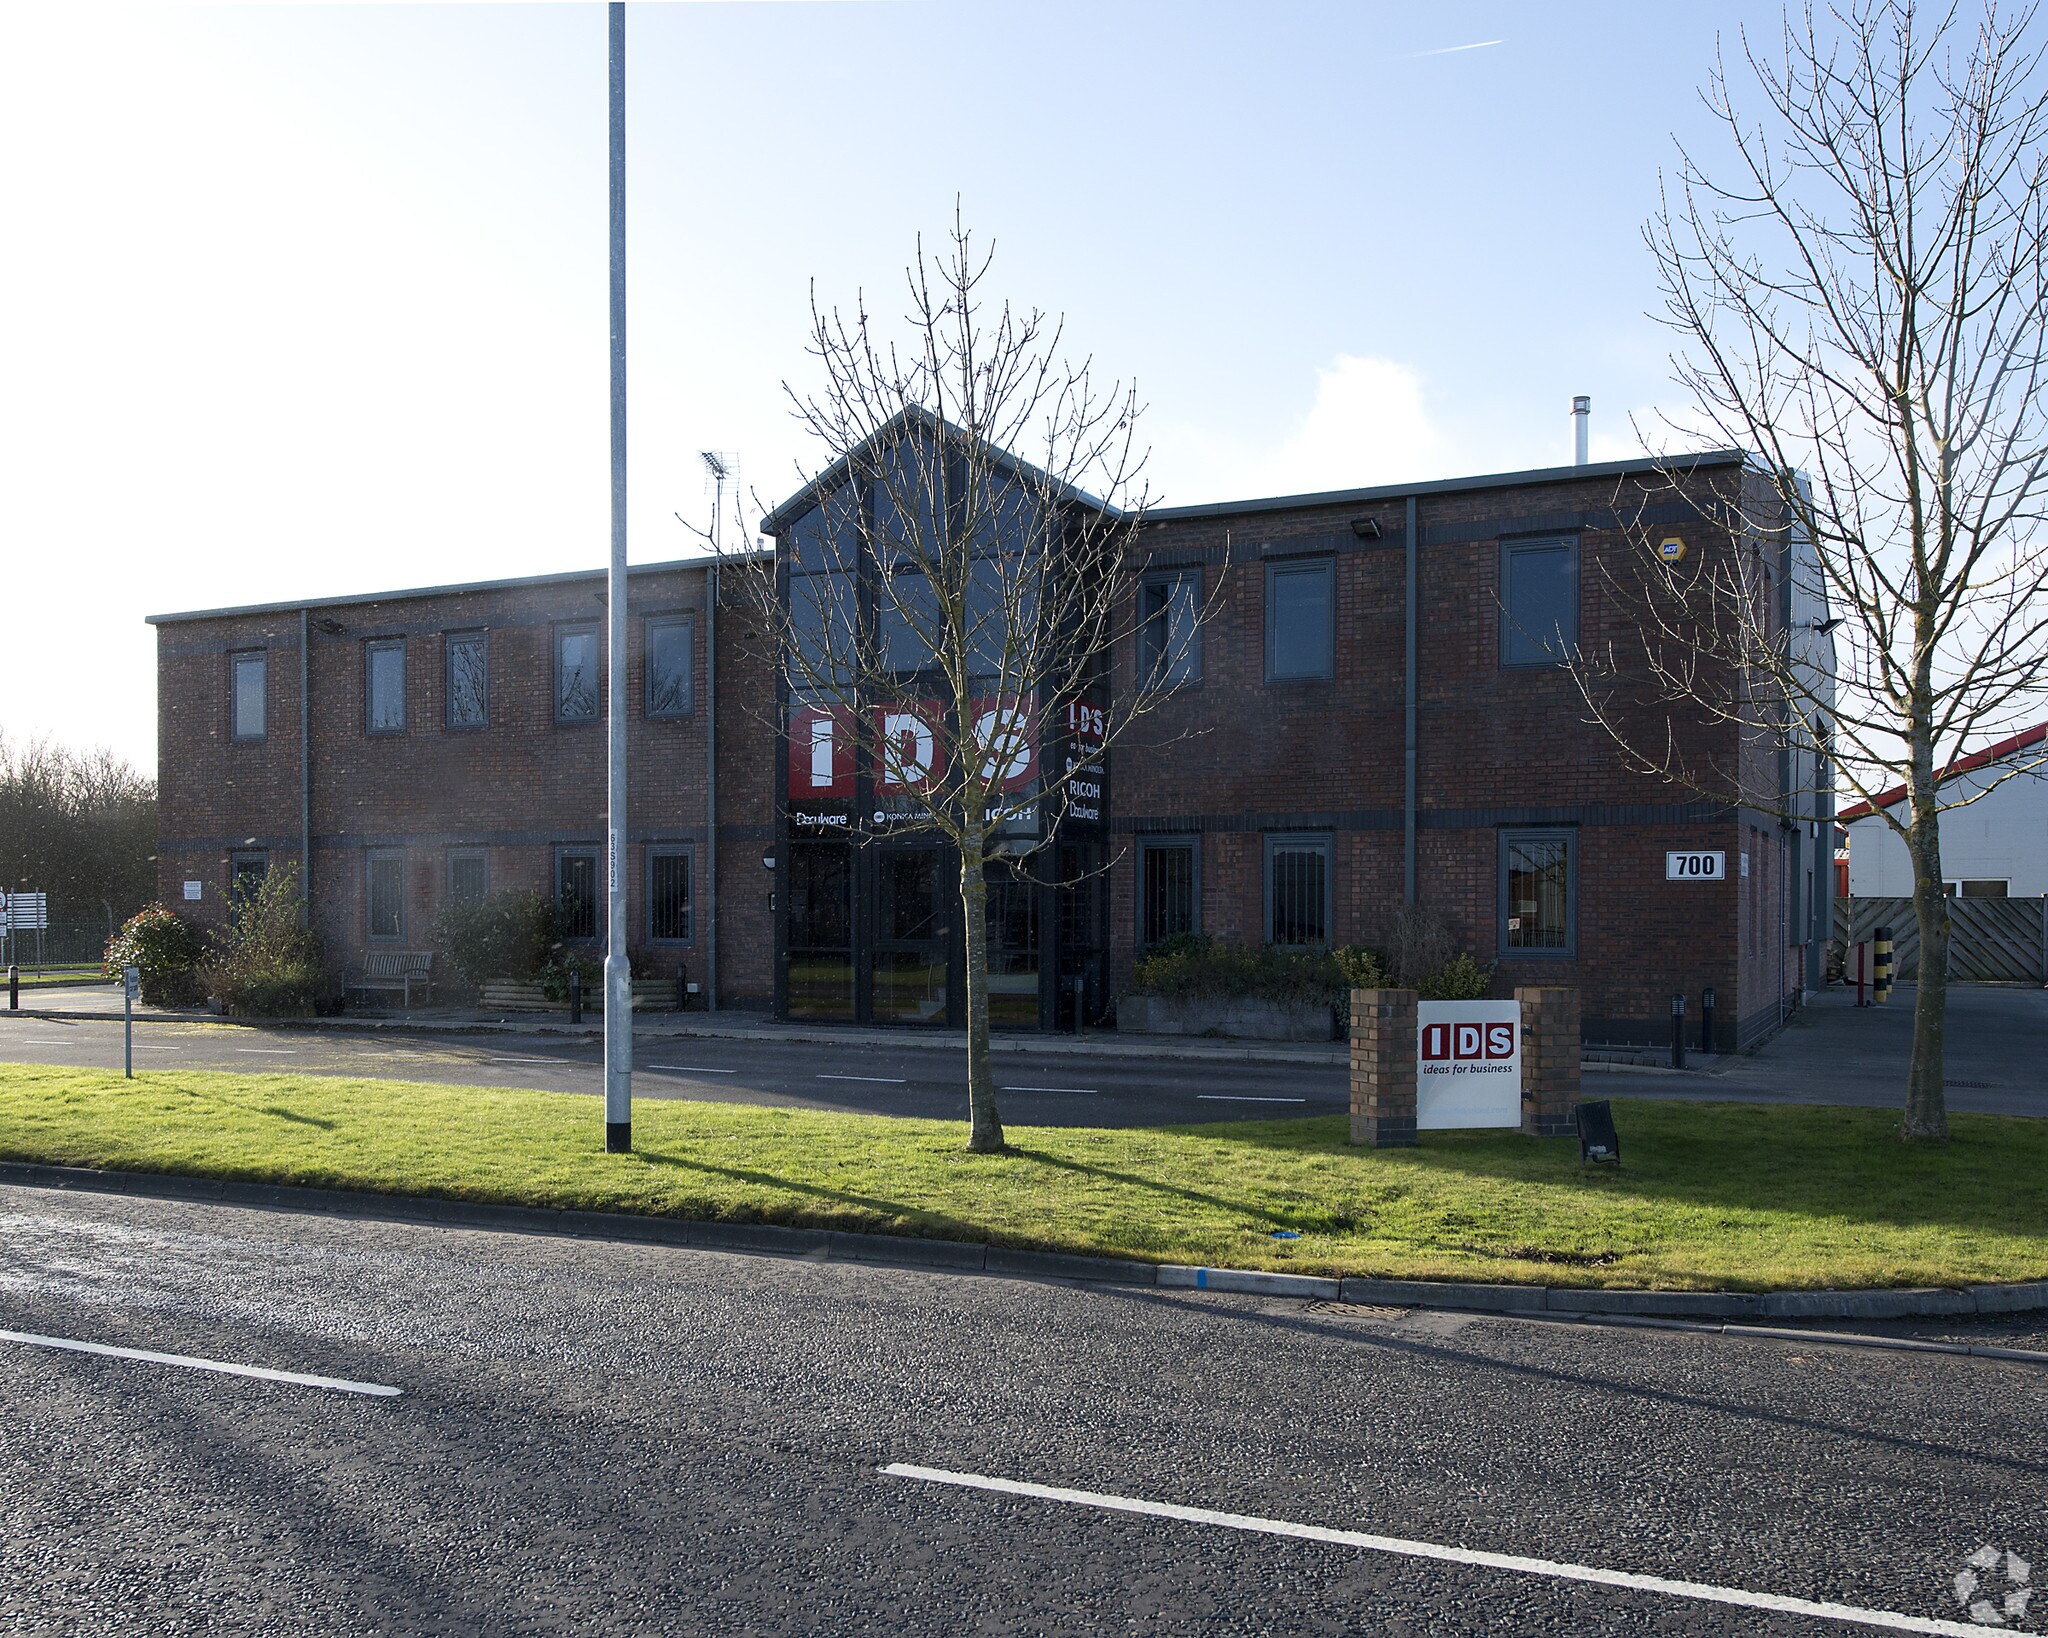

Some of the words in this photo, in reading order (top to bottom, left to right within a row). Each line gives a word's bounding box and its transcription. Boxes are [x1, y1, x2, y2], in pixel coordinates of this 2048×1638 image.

[1664, 545, 1678, 553] ADT
[1070, 703, 1103, 735] IDS
[1070, 780, 1100, 799] RICOH
[983, 807, 1031, 821] ICOH
[1676, 855, 1715, 875] 700
[1431, 1027, 1512, 1056] IDS
[1423, 1064, 1450, 1075] ideas
[1452, 1063, 1468, 1076] for
[1469, 1063, 1513, 1074] business
